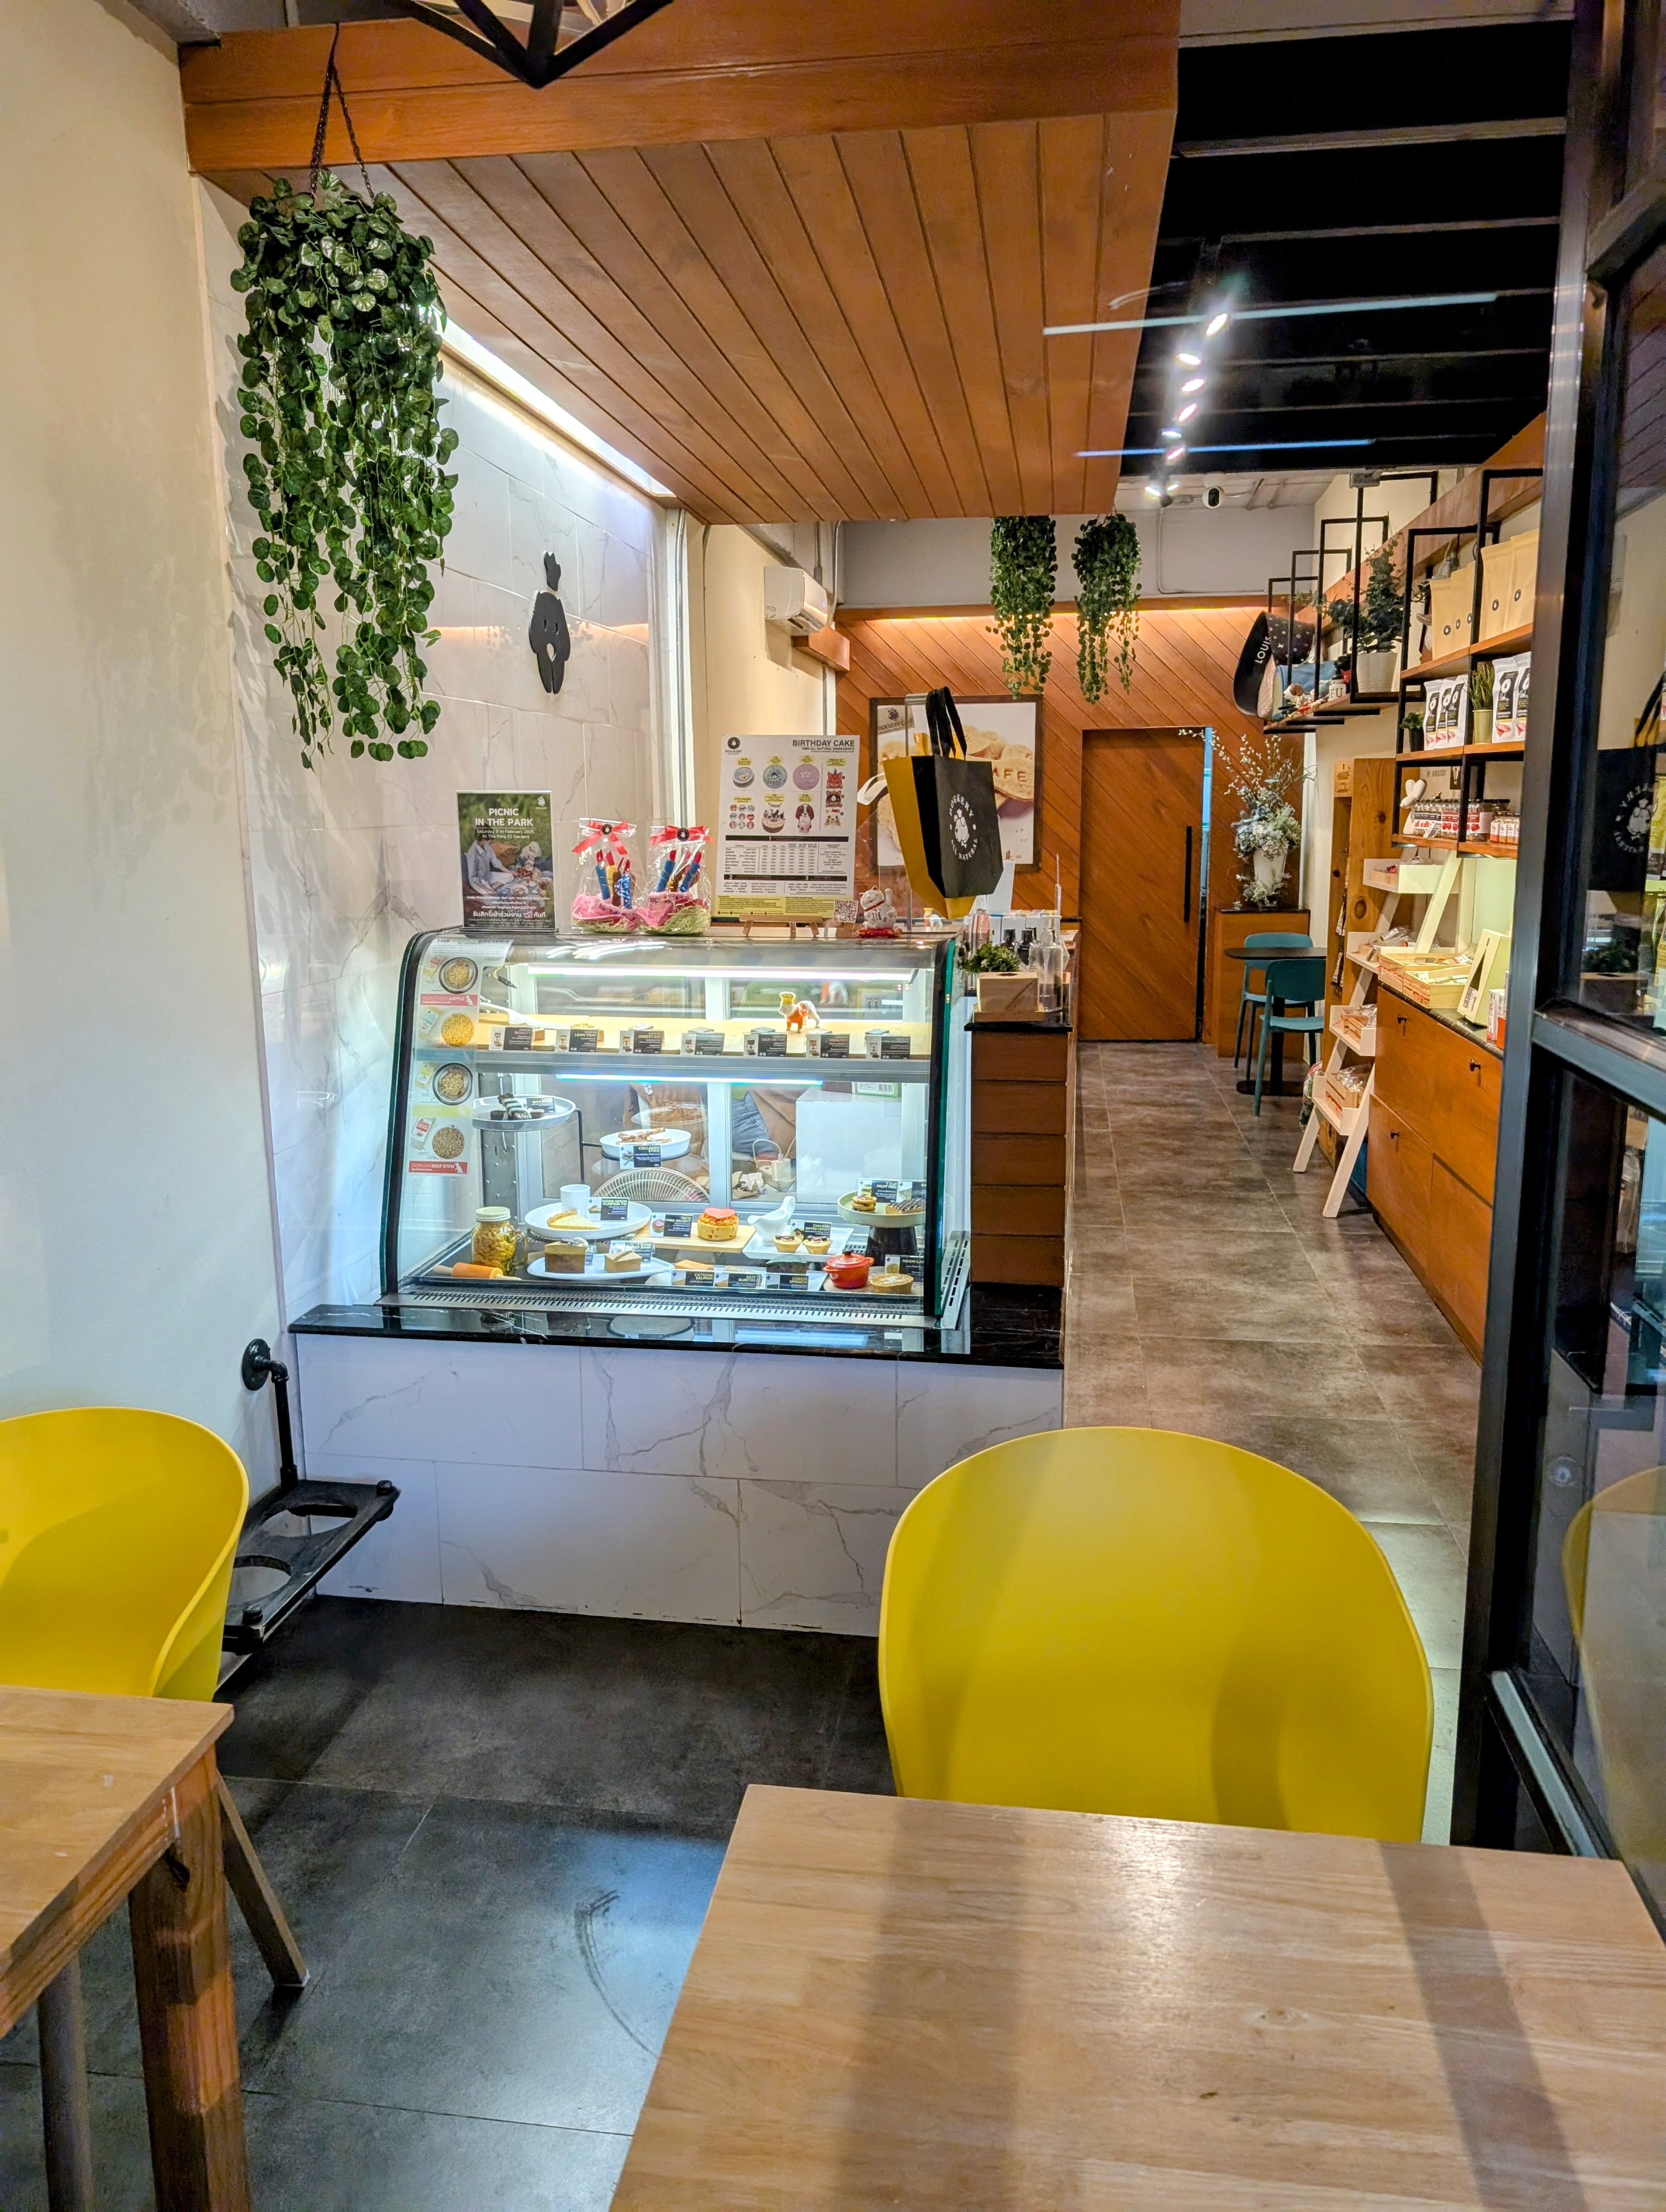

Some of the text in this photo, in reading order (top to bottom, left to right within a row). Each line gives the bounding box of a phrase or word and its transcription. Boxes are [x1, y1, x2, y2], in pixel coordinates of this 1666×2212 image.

[949, 794, 974, 818] DOGKERY
[489, 808, 520, 816] PICNIC
[487, 818, 505, 826] THE
[507, 818, 534, 826] PARK
